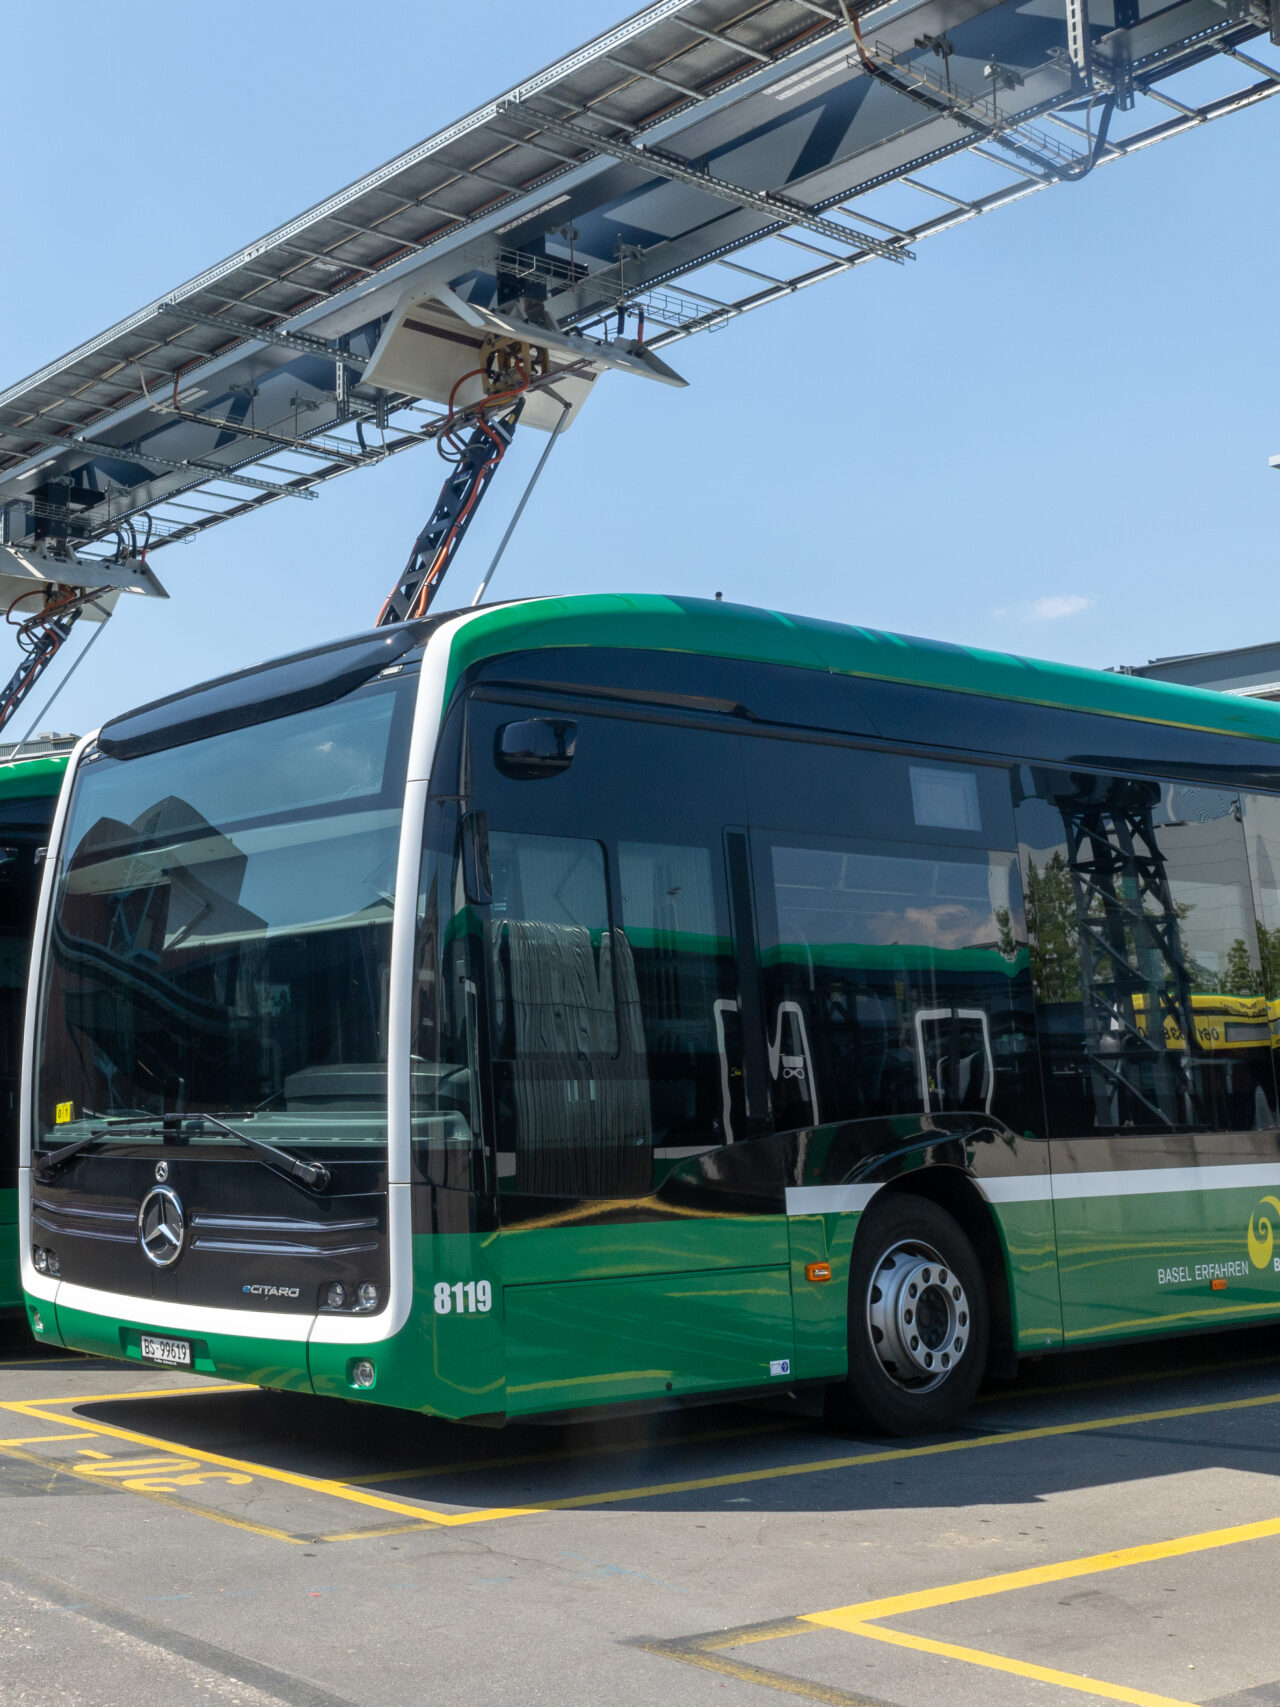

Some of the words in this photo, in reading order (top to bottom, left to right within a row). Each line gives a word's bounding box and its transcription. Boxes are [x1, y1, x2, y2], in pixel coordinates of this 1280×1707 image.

[1157, 1266, 1192, 1284] BASEL
[1195, 1260, 1249, 1280] ERFAHREN
[433, 1280, 492, 1315] 8119
